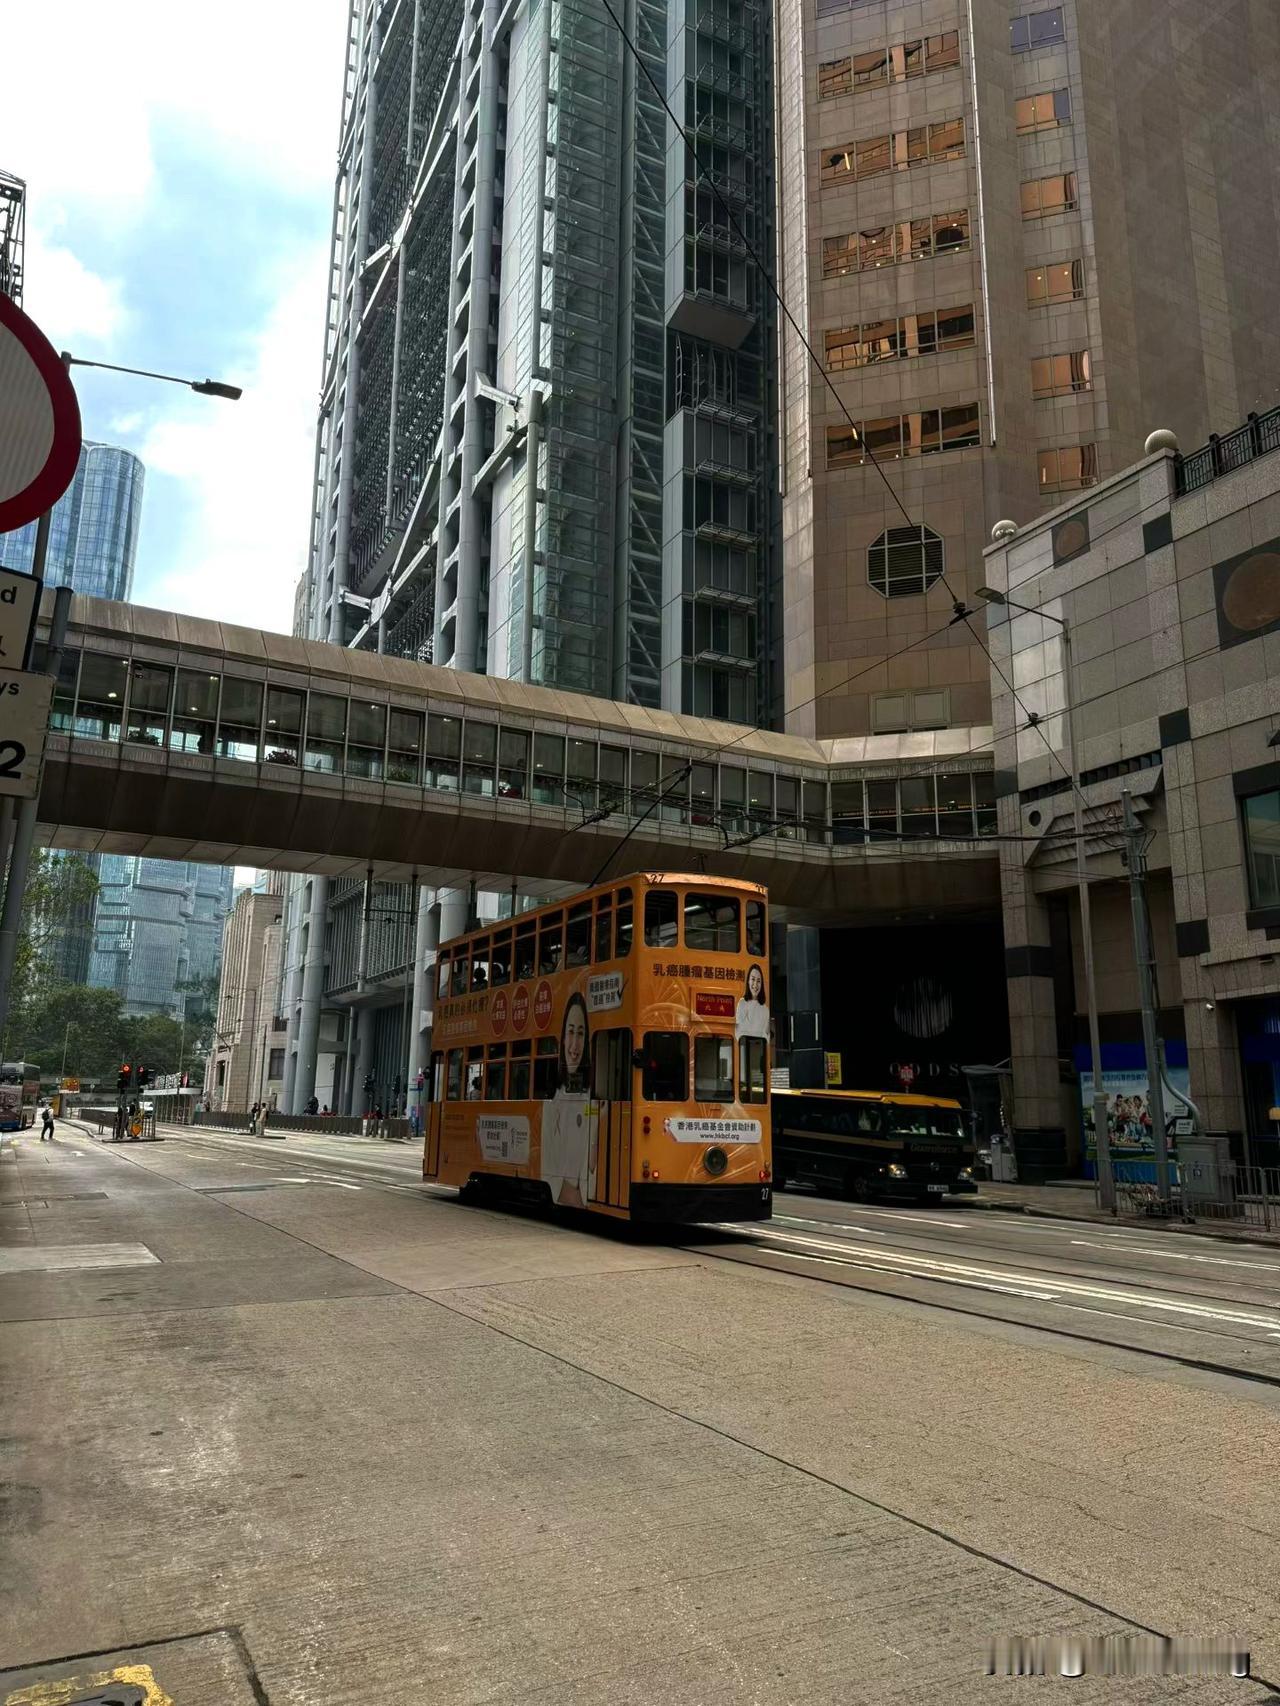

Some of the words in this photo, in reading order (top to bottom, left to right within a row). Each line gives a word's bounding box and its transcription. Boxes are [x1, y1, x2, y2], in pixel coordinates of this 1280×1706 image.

[650, 873, 664, 884] 27
[652, 963, 745, 982] 乳癌腫瘤基因檢測
[700, 1132, 740, 1141] www.hkbcf.org
[760, 1187, 770, 1200] 27
